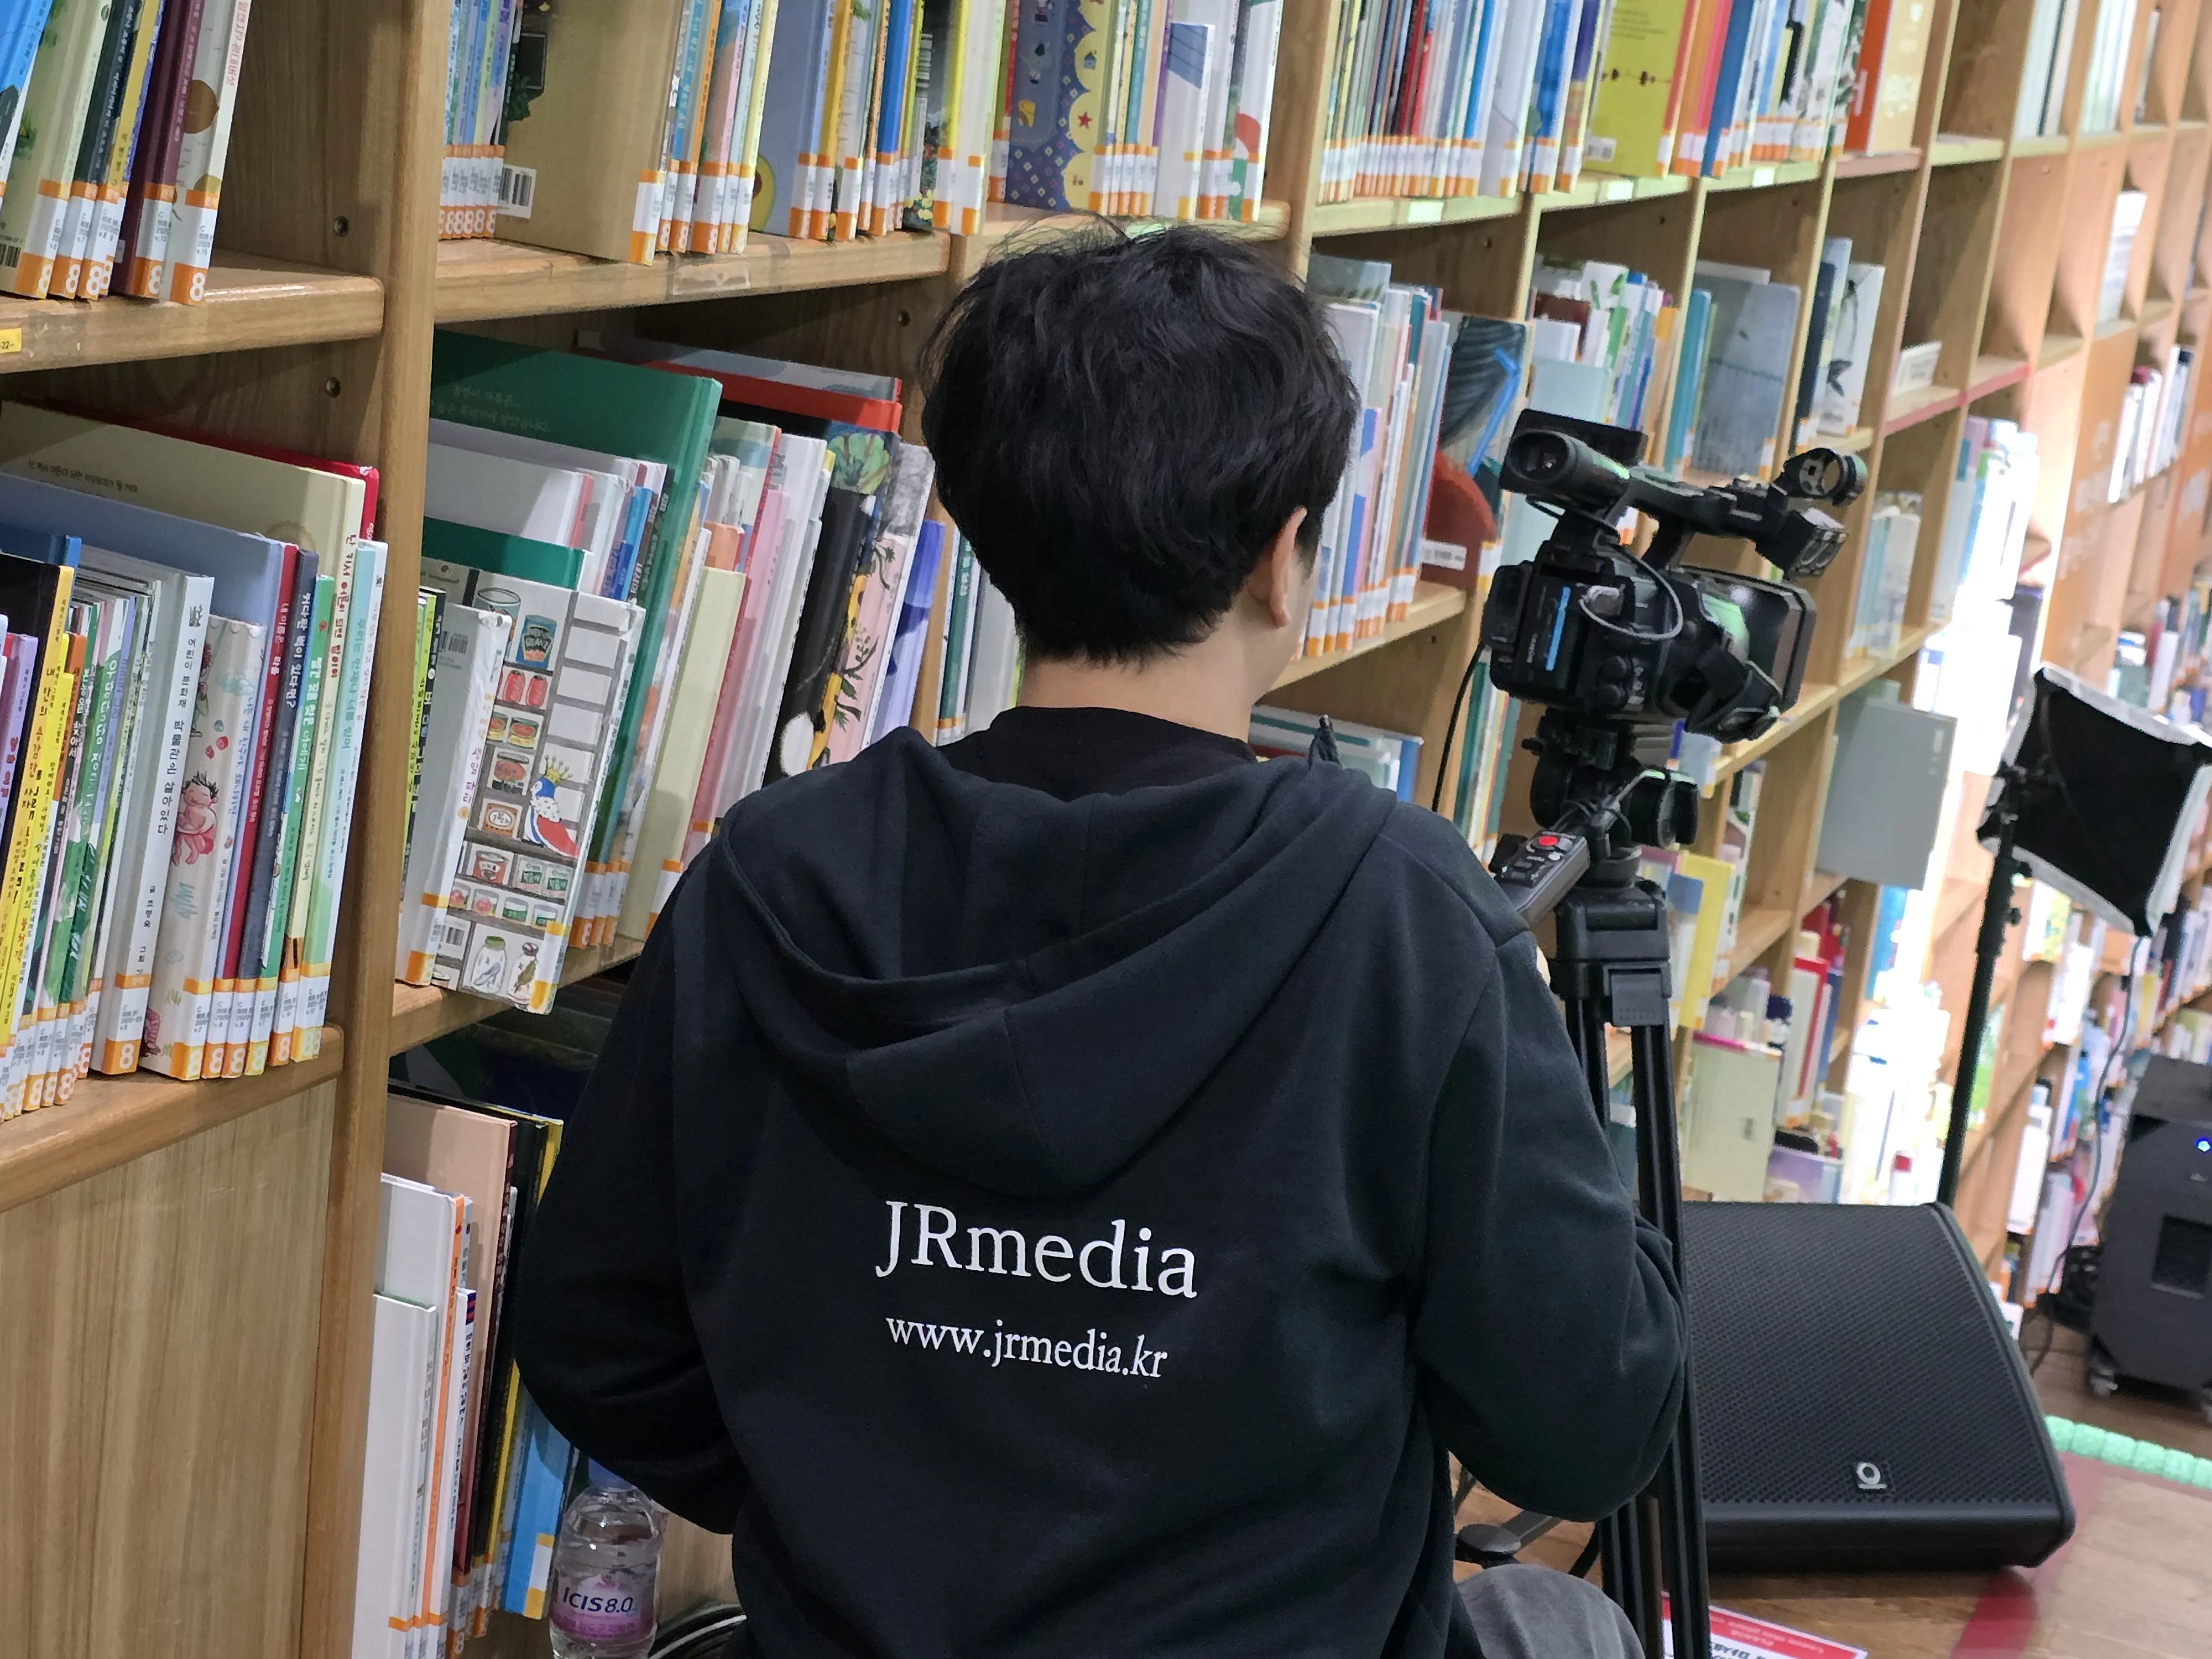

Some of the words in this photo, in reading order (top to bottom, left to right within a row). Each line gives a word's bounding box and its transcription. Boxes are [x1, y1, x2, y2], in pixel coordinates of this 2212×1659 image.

[445, 211, 454, 234] 8
[454, 211, 465, 234] 8
[463, 210, 474, 234] 8
[474, 209, 485, 233] 8
[486, 210, 497, 234] 8
[660, 224, 671, 248] 8
[679, 225, 689, 248] 8
[39, 264, 52, 293] 8
[66, 264, 80, 293] 8
[86, 266, 103, 295] 8
[148, 265, 162, 294] 8
[190, 272, 206, 301] 8
[346, 534, 357, 546] 난
[343, 552, 354, 576] 커서
[280, 603, 289, 613] 내
[337, 581, 349, 612] 어른이
[297, 593, 311, 630] 커다란
[276, 614, 288, 644] 이름은
[334, 618, 343, 638] 되면
[294, 635, 306, 658] 벽이
[331, 644, 341, 678] 말이야
[286, 663, 301, 708] 있다면?
[349, 658, 362, 692] 언제나
[243, 697, 254, 714] 너는
[346, 700, 356, 721] 너를
[242, 721, 250, 731] 내
[166, 720, 184, 775] 박물관은
[298, 729, 310, 770] 너에게
[158, 782, 175, 834] 살아있다
[278, 1037, 291, 1061] 8
[301, 1031, 315, 1055] 8
[119, 1043, 134, 1070] 8
[188, 1051, 203, 1077] 8
[210, 1047, 224, 1074] 8
[231, 1048, 246, 1073] 8
[252, 1045, 267, 1072] 8
[29, 1079, 43, 1105] 8
[43, 1076, 56, 1103] 8
[58, 1073, 72, 1100] 8
[876, 1201, 1197, 1298] JRmedia
[886, 1318, 1167, 1377] www.jrmedia.kr
[604, 1597, 633, 1613] 8.0
[455, 1631, 465, 1655] 8
